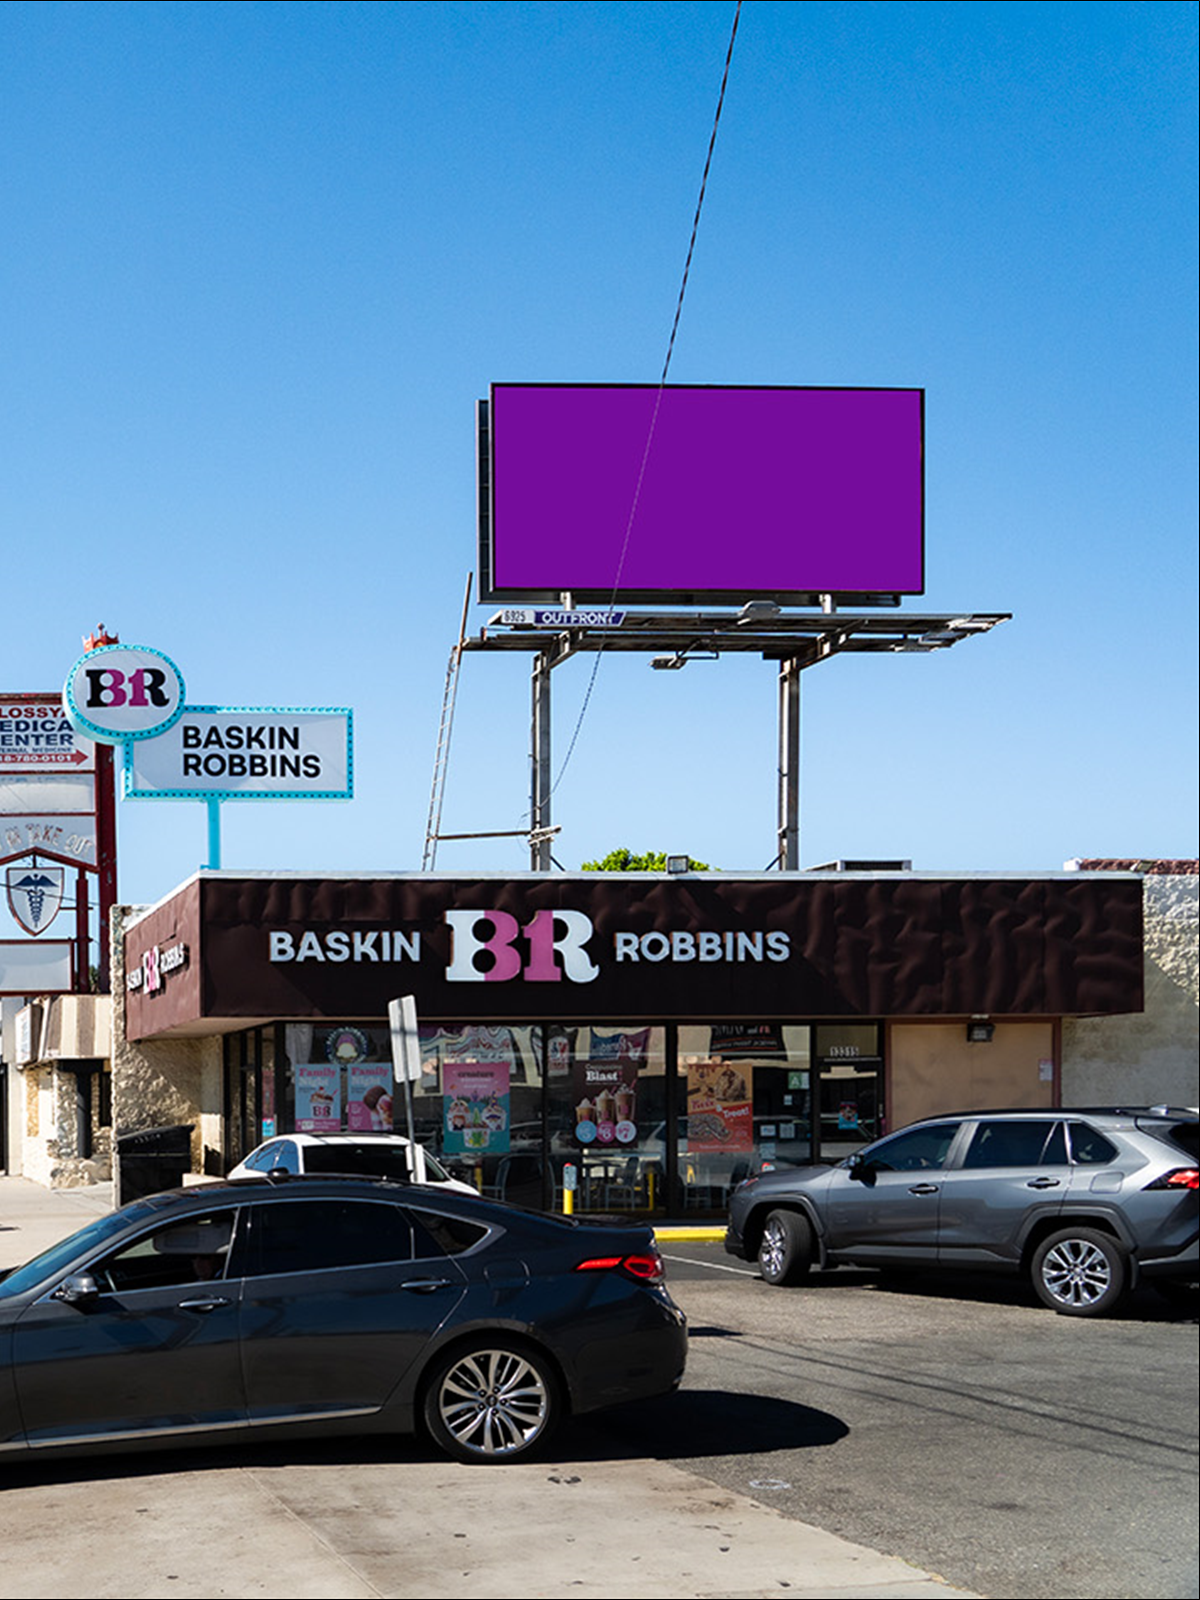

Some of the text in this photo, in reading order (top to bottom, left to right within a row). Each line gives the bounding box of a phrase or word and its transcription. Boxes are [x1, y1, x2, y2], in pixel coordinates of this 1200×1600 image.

[541, 612, 615, 624] OUTFRONT
[85, 668, 170, 708] BR
[183, 726, 300, 750] BASKIN
[183, 754, 321, 778] ROBBINS
[268, 909, 790, 983] BASKIN BR ROBBINS
[299, 1067, 337, 1079] Family
[351, 1066, 390, 1078] Family
